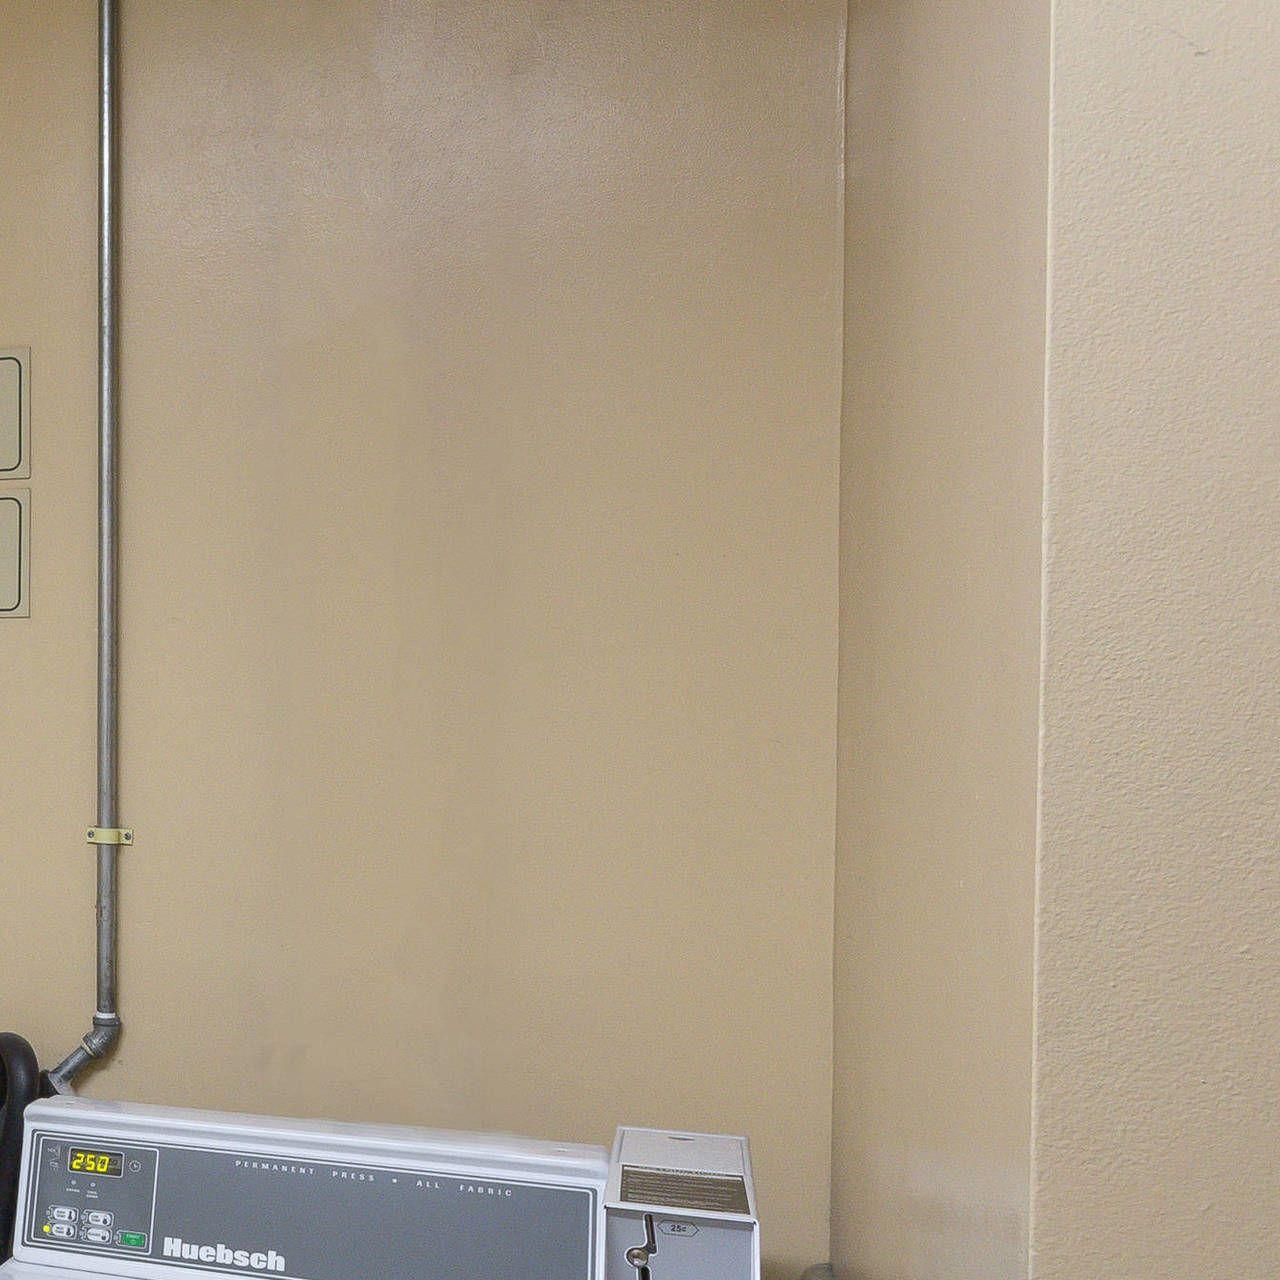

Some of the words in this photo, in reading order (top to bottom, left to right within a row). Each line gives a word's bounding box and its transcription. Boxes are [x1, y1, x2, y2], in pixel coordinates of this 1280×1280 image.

[72, 1151, 110, 1173] 250
[235, 1159, 315, 1175] PERMANENT
[332, 1170, 375, 1182] PRESS
[416, 1180, 440, 1190] ALL
[459, 1184, 513, 1197] FABRIC
[162, 1236, 285, 1272] Huebsch
